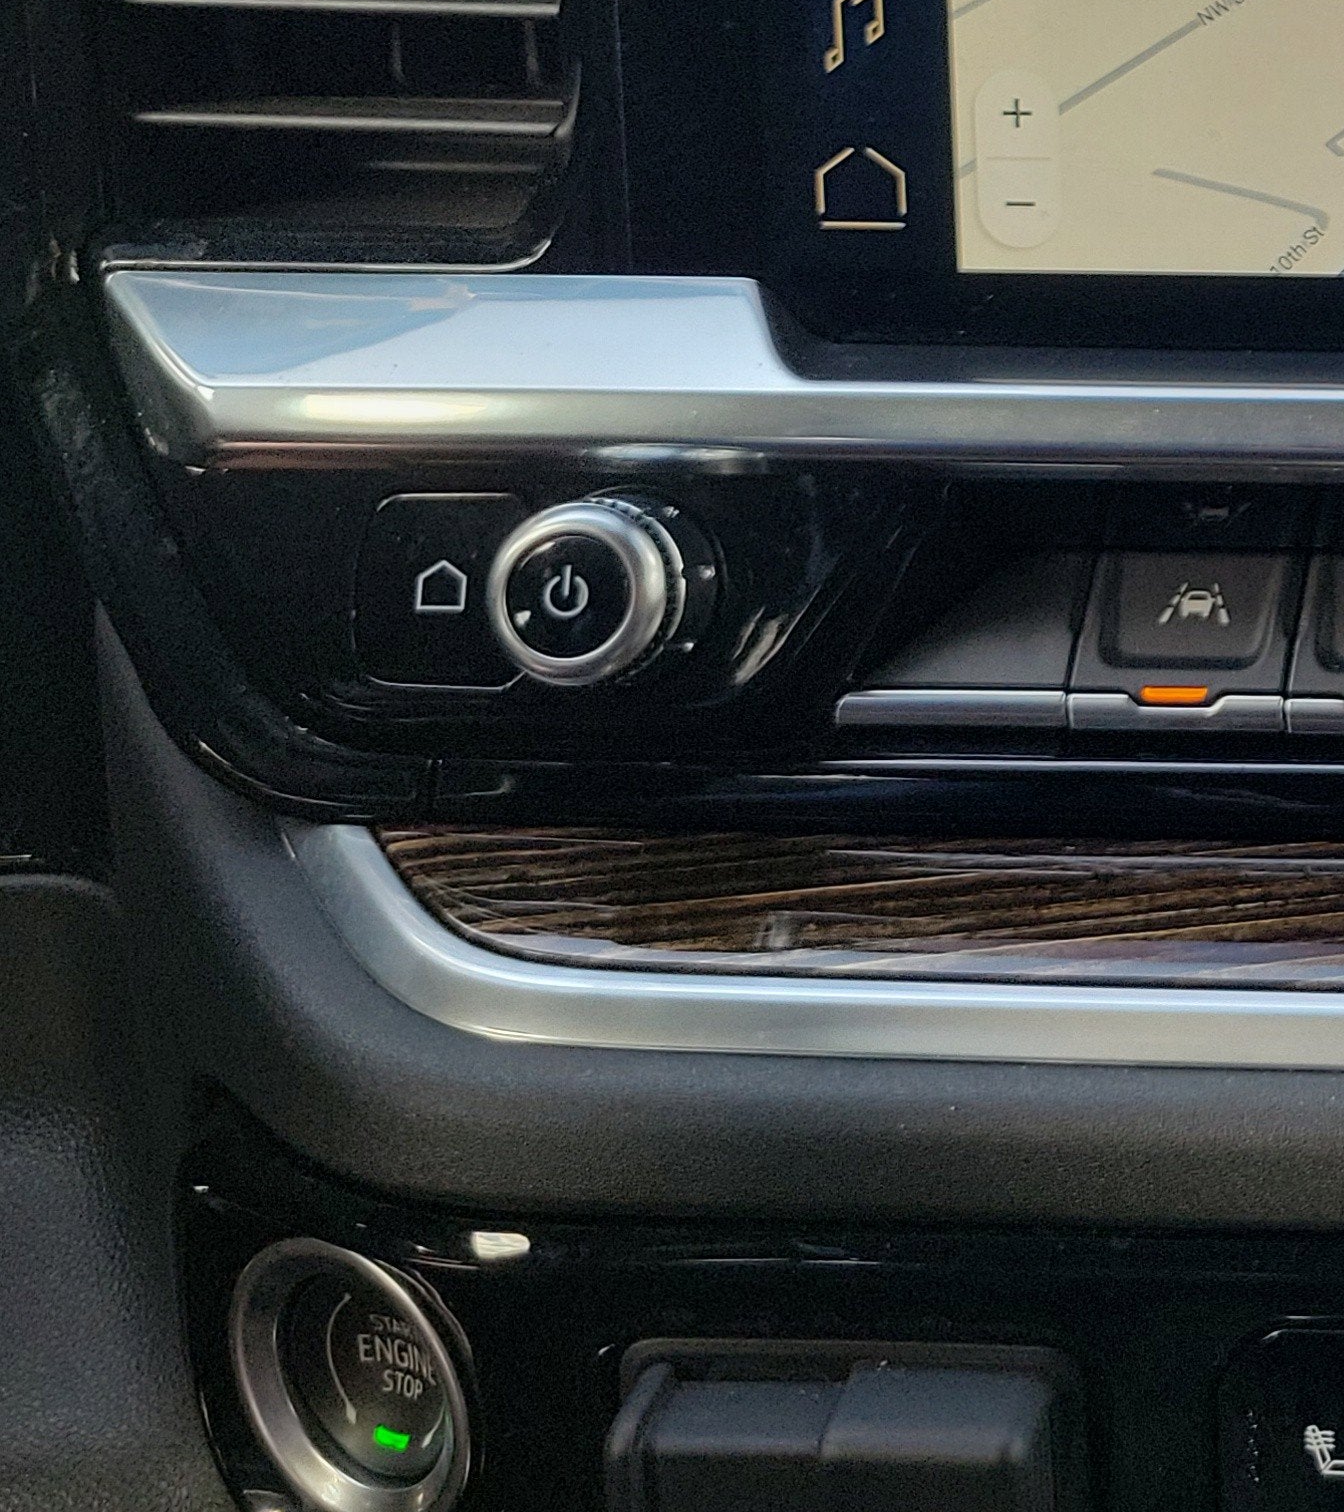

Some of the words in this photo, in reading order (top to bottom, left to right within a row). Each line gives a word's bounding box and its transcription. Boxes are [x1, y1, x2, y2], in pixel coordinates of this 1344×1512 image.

[1302, 226, 1325, 246] St
[357, 1333, 437, 1386] ENGINE
[382, 1368, 424, 1400] STOP
